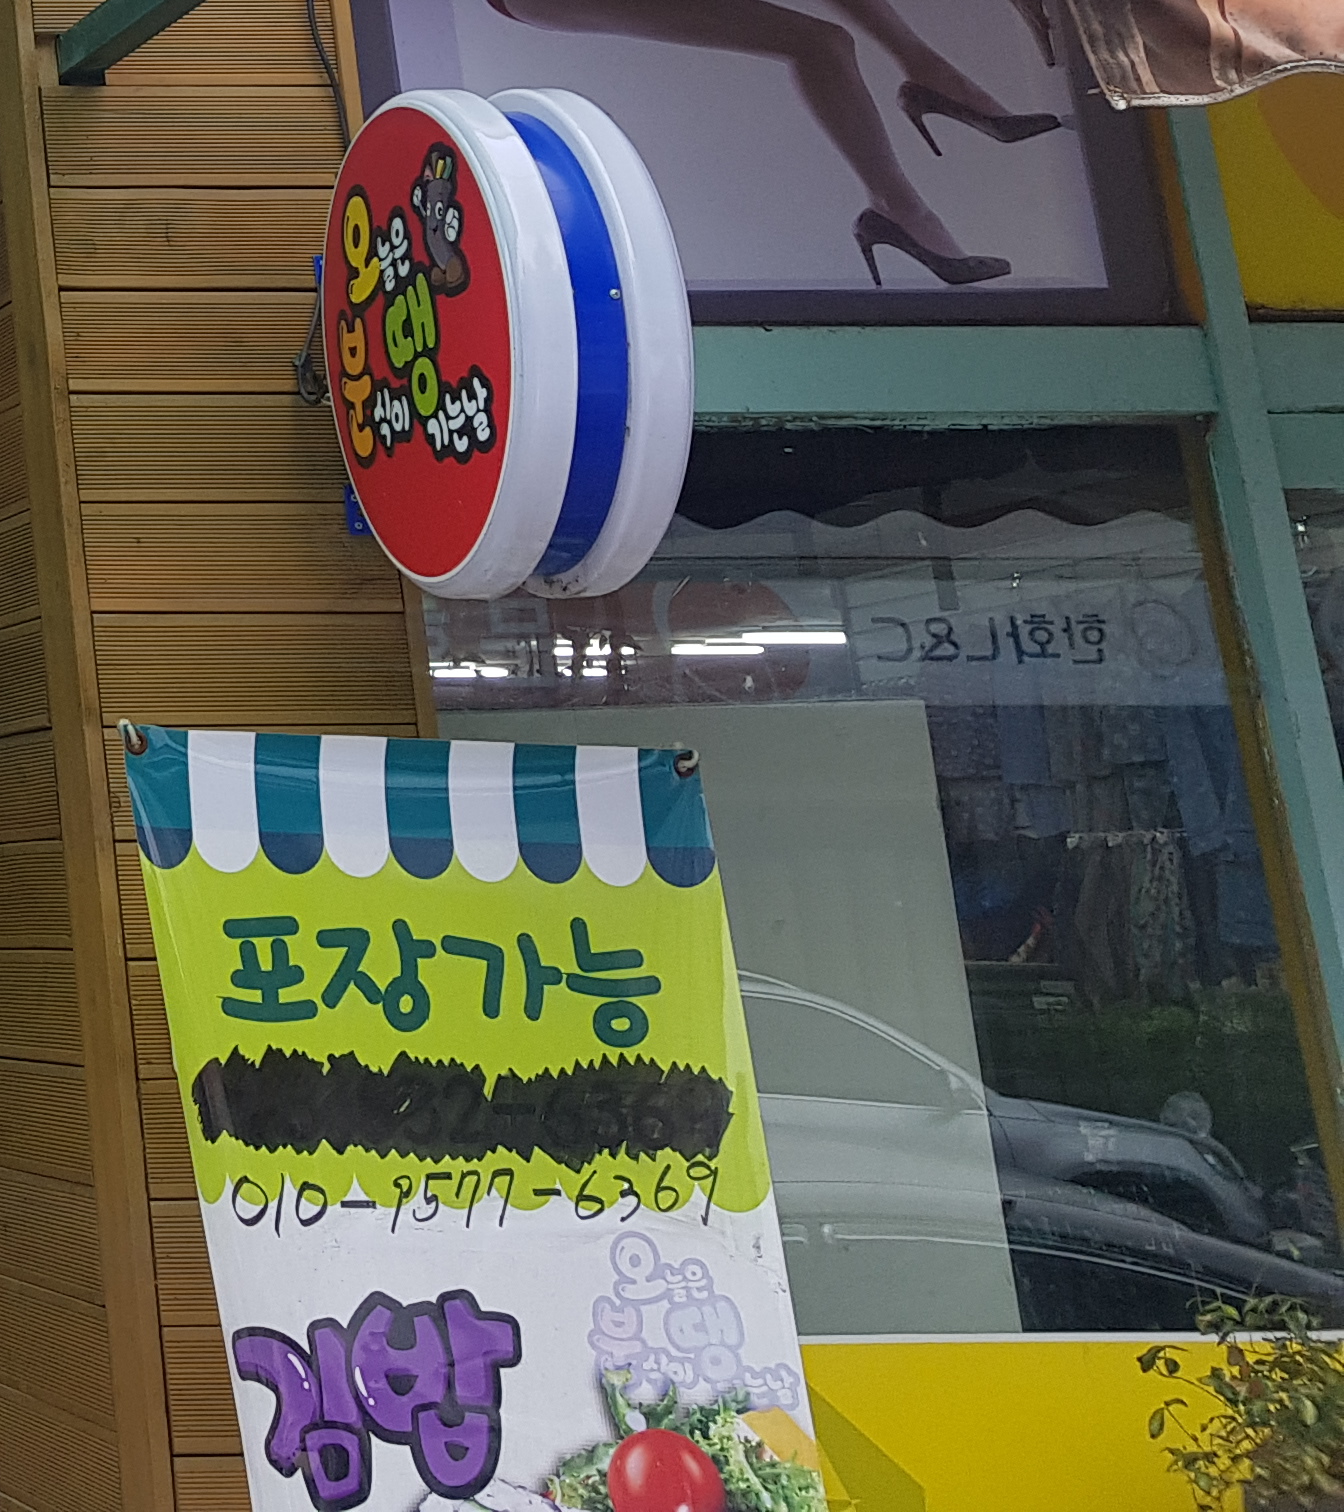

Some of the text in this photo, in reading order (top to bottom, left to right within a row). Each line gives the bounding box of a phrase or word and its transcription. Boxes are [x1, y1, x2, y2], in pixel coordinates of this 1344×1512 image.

[343, 194, 410, 304] 오늘은
[340, 317, 409, 458] 분식이
[219, 916, 662, 1048] 포장가능
[231, 1158, 719, 1238] 010-9577-6369
[232, 1291, 522, 1512] 김밥
